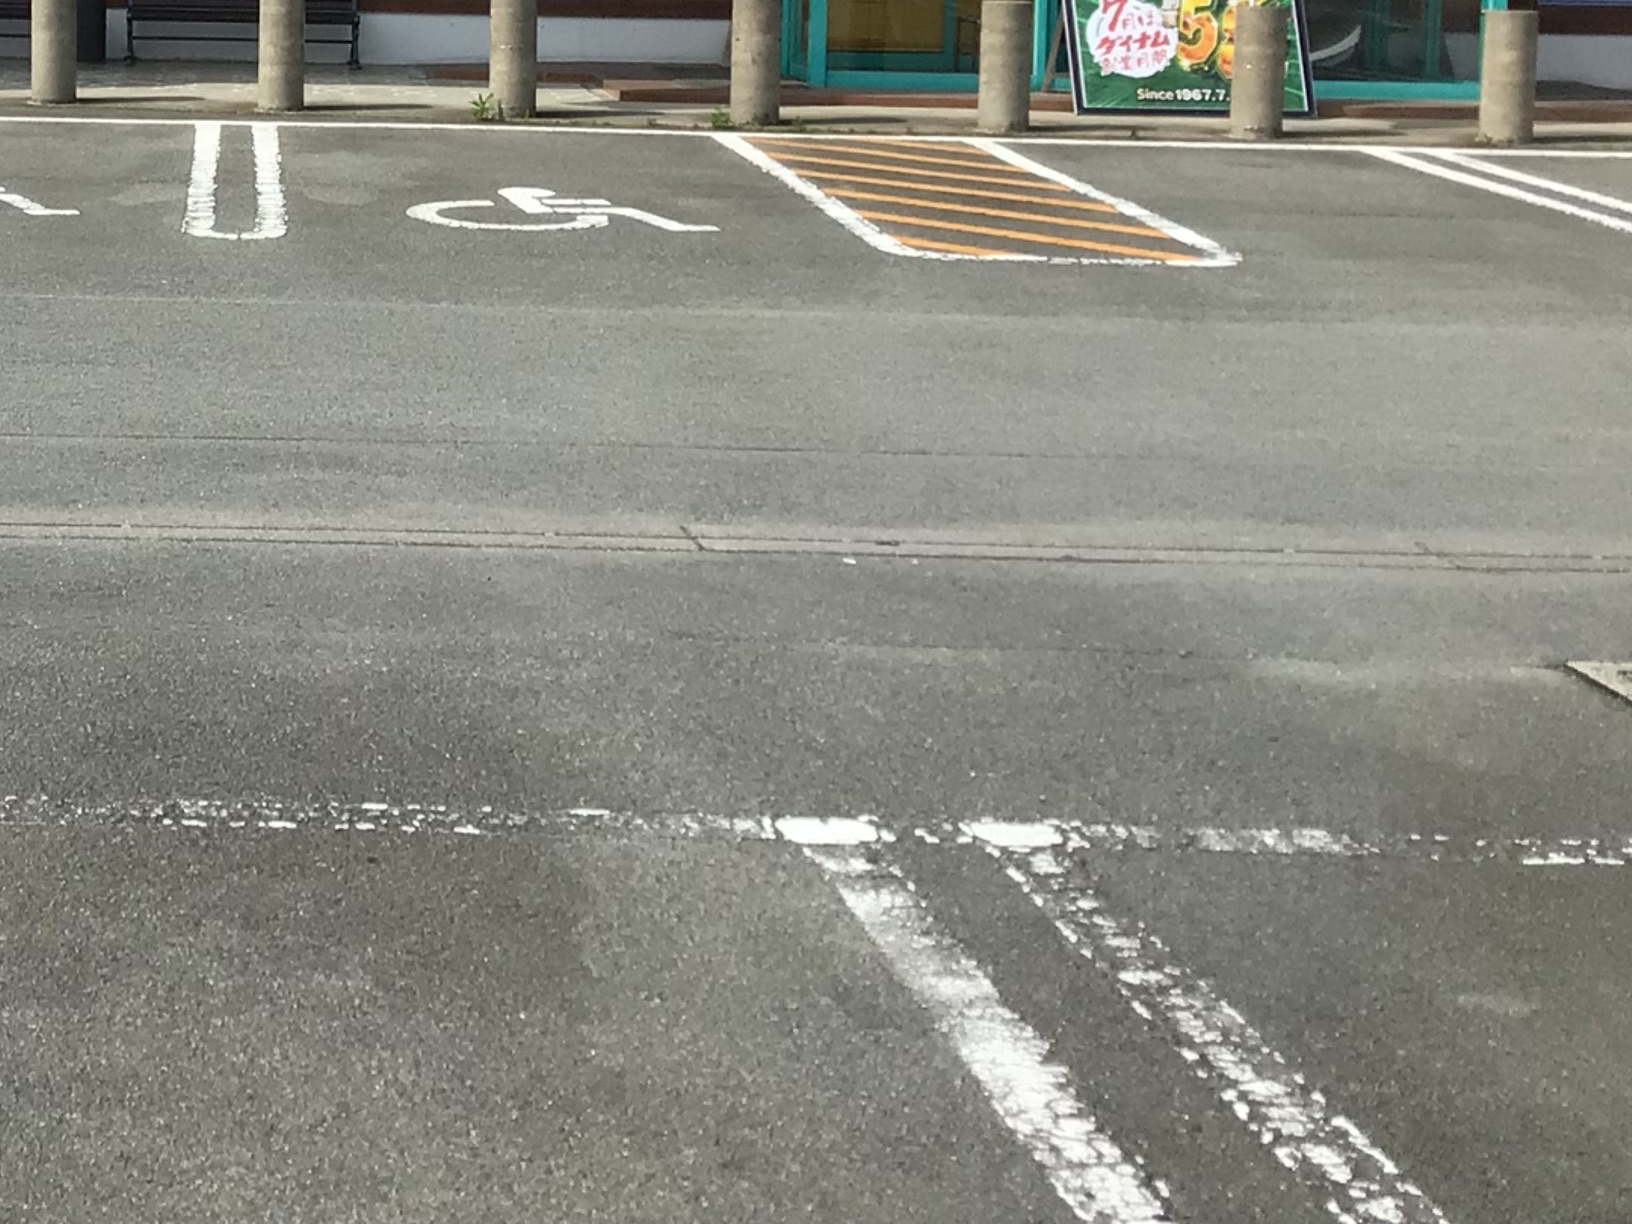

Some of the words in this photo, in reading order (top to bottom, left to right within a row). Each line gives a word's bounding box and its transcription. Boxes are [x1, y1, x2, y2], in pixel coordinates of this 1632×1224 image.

[1096, 30, 1171, 57] ダイナム
[1136, 88, 1175, 101] Since
[1175, 88, 1231, 102] 1967.7.
